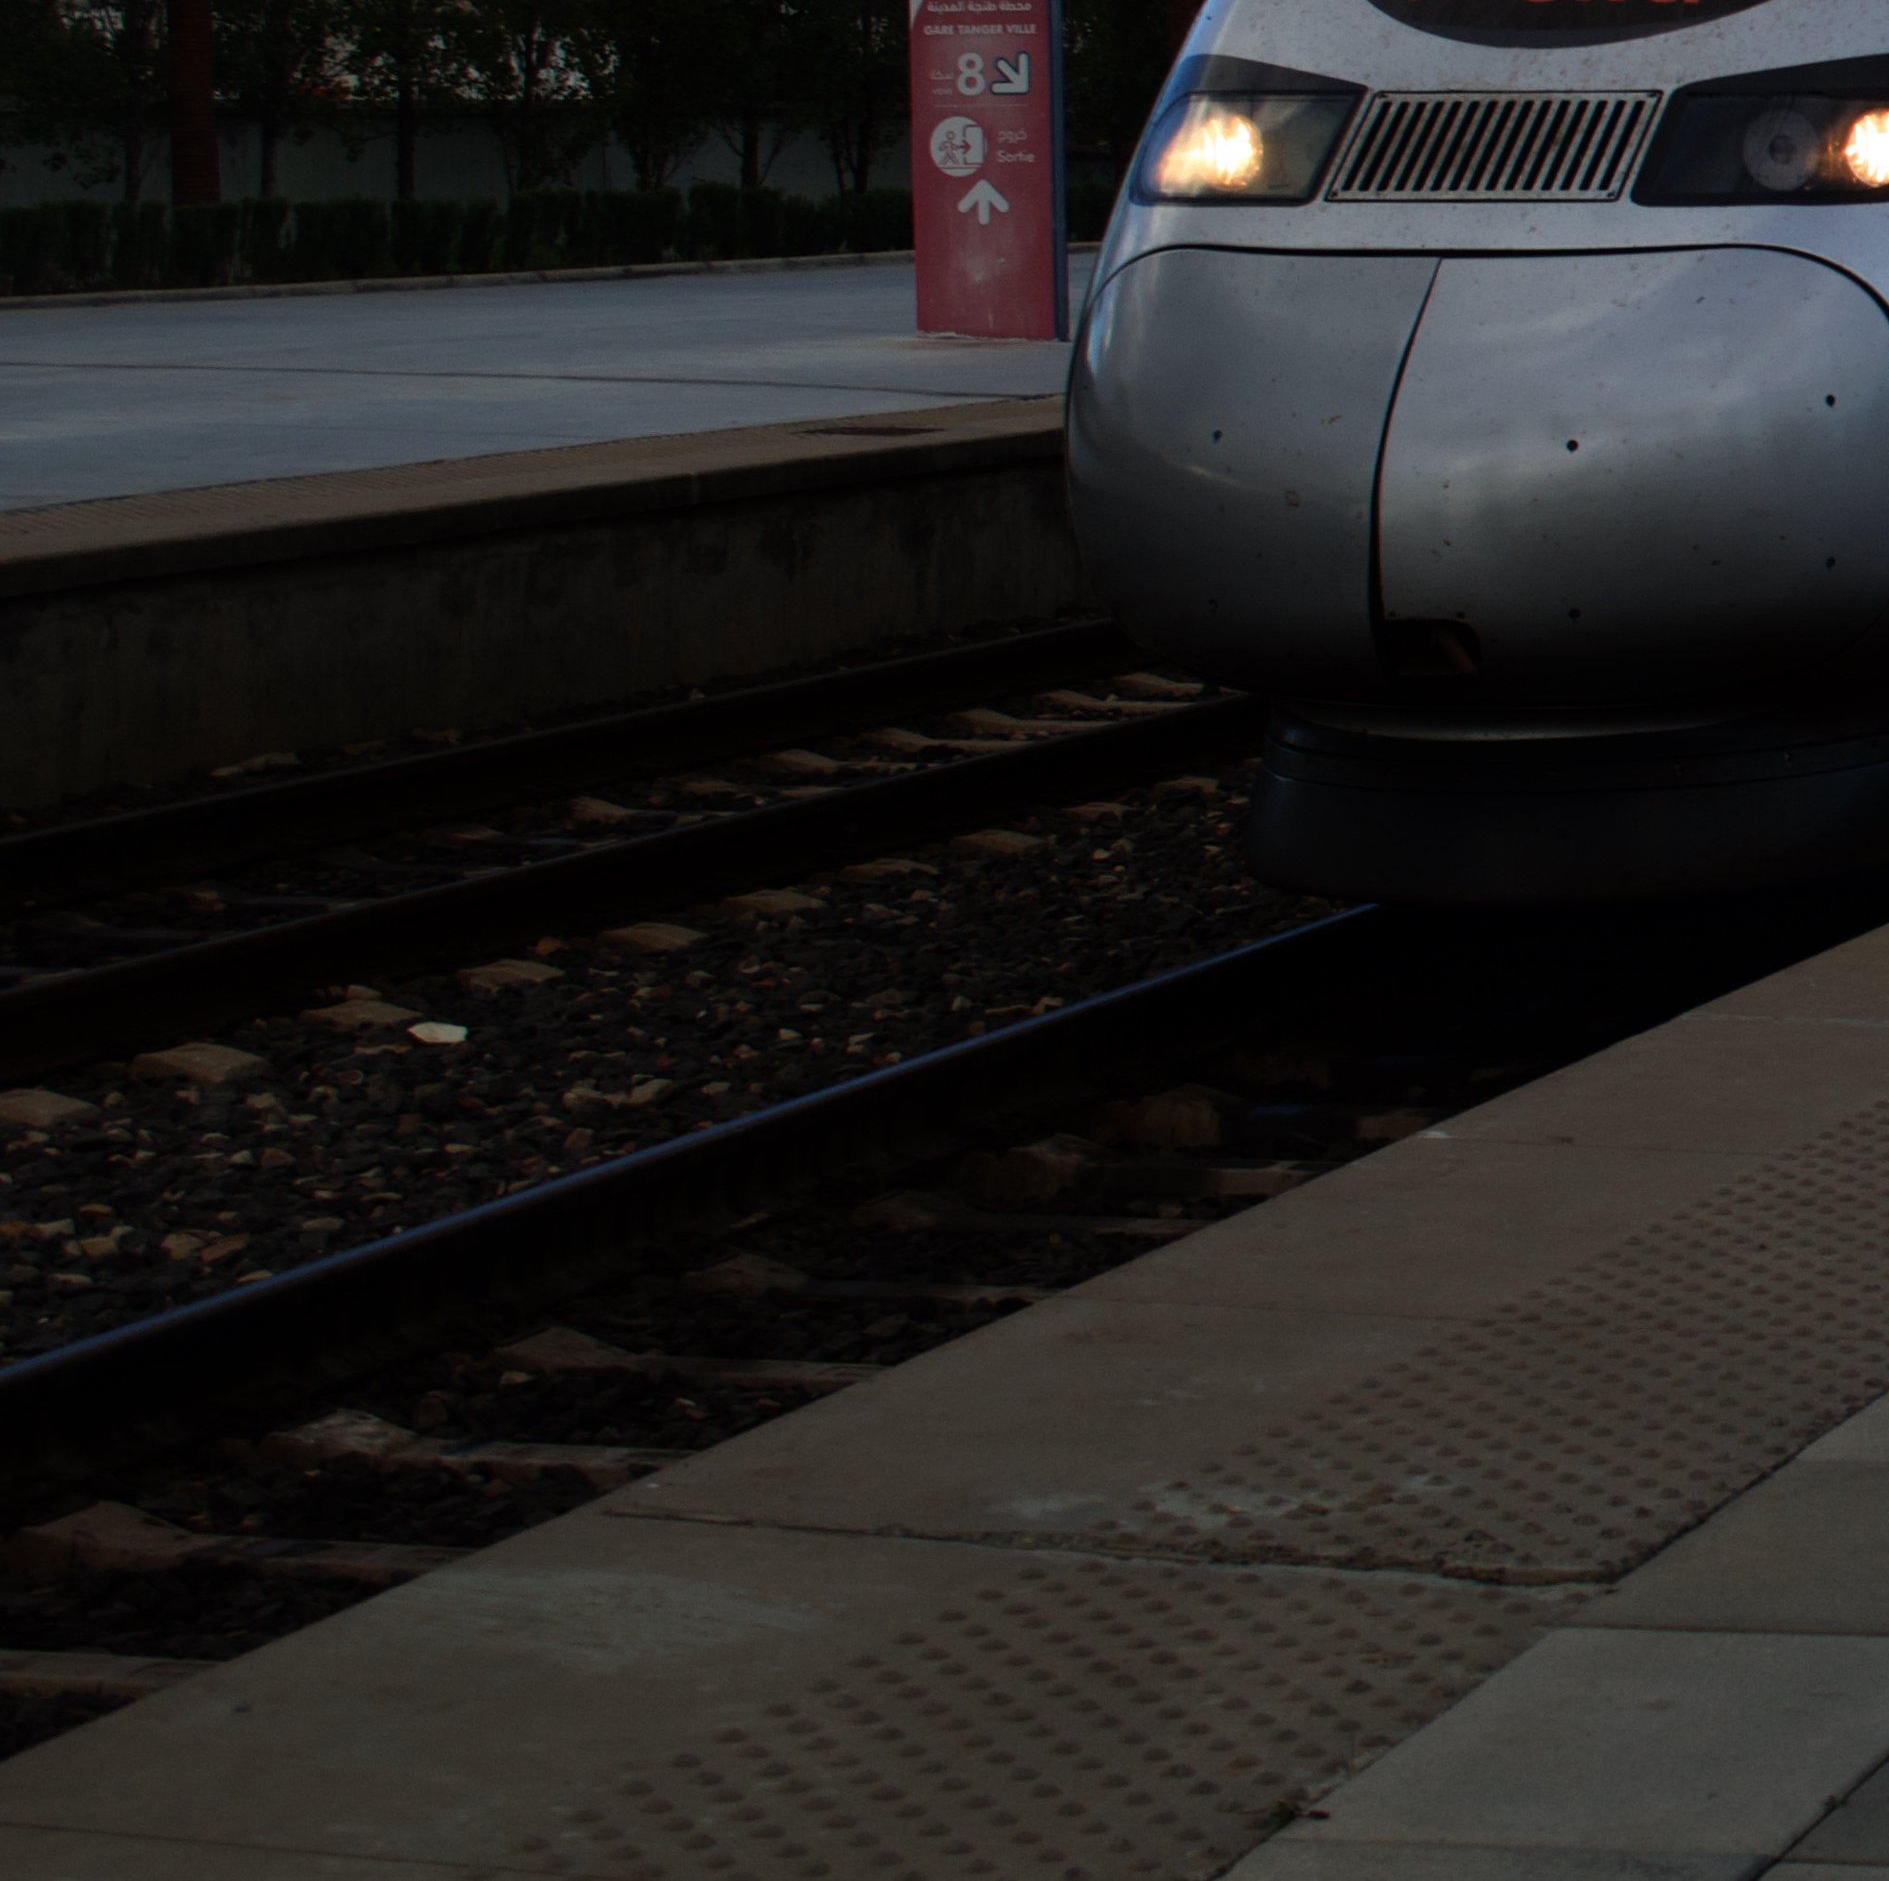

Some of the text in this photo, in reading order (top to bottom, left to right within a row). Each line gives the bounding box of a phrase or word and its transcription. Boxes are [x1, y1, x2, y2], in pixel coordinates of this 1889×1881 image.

[927, 0, 1032, 15] محطة طنجة المدينة
[924, 23, 1038, 35] GARE TANGER VILLE
[957, 52, 986, 97] 8
[997, 127, 1028, 144] خروج
[996, 149, 1036, 163] Sortie
